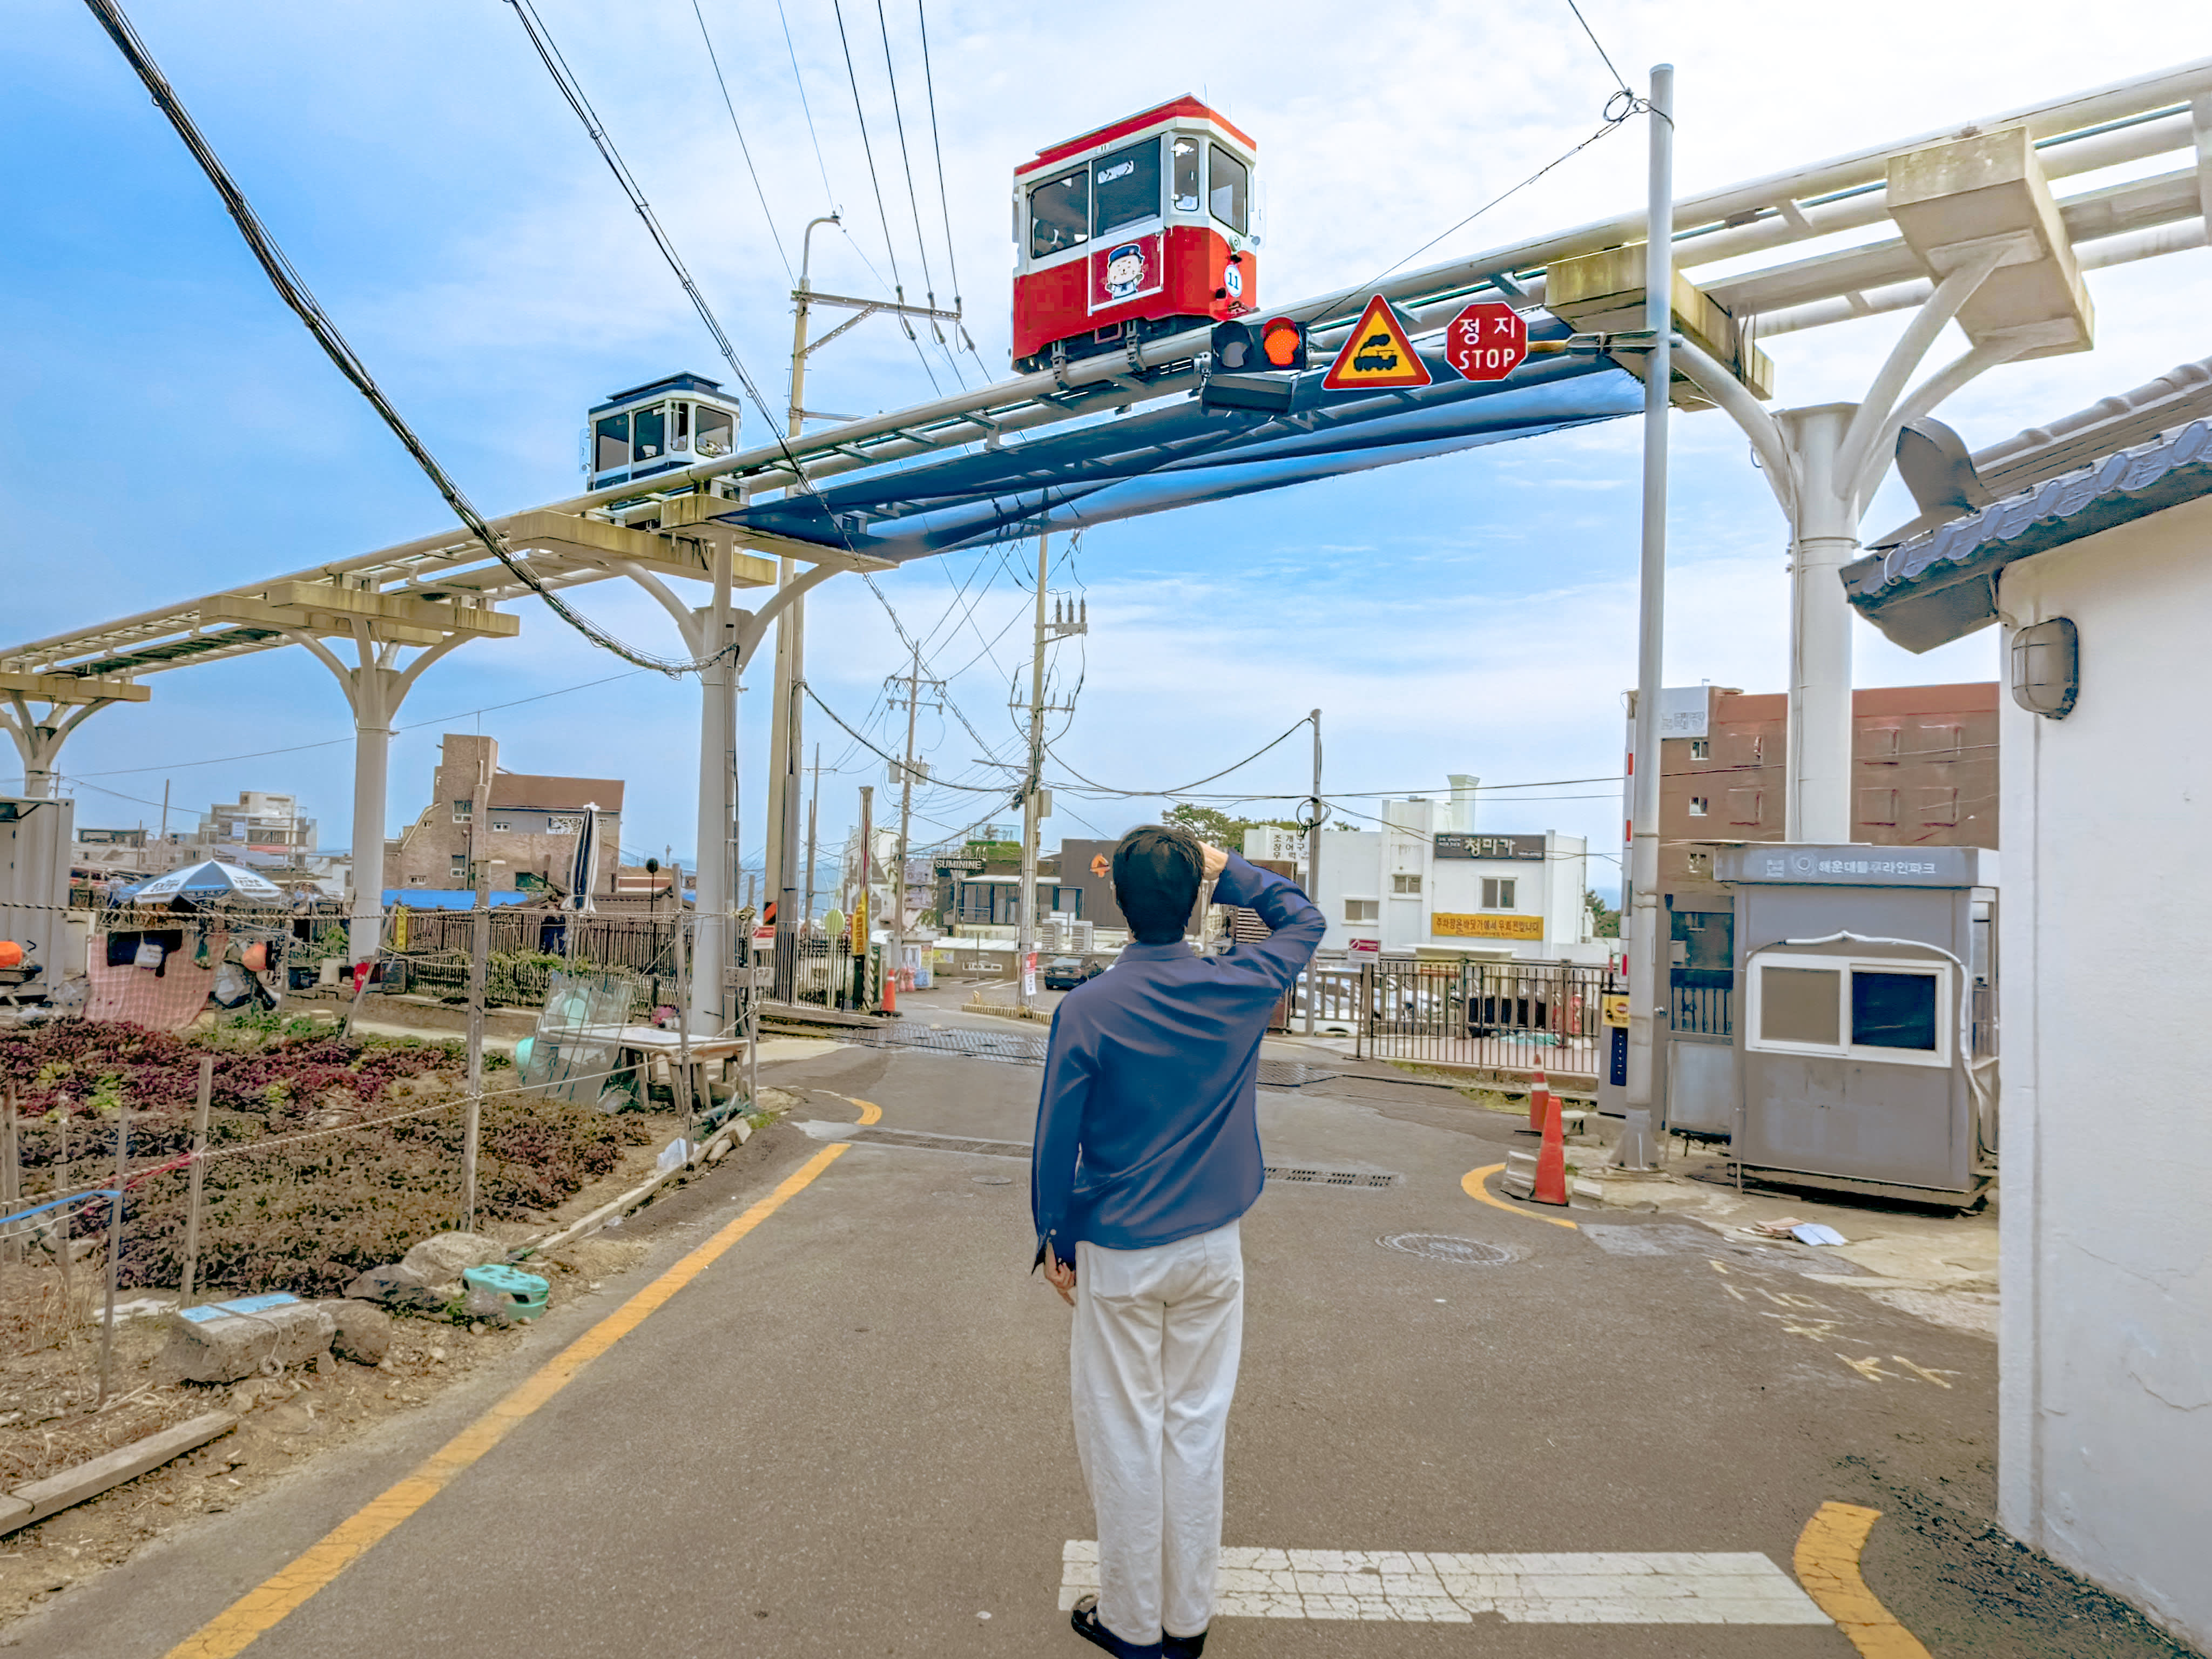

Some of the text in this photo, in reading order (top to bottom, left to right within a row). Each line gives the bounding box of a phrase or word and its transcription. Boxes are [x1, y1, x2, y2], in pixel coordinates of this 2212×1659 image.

[1228, 272, 1239, 290] 11
[1459, 348, 1515, 370] STOP
[1465, 838, 1516, 857] 청미가
[935, 859, 982, 869] SUMININE
[1818, 860, 1936, 874] 해운대루라인파크
